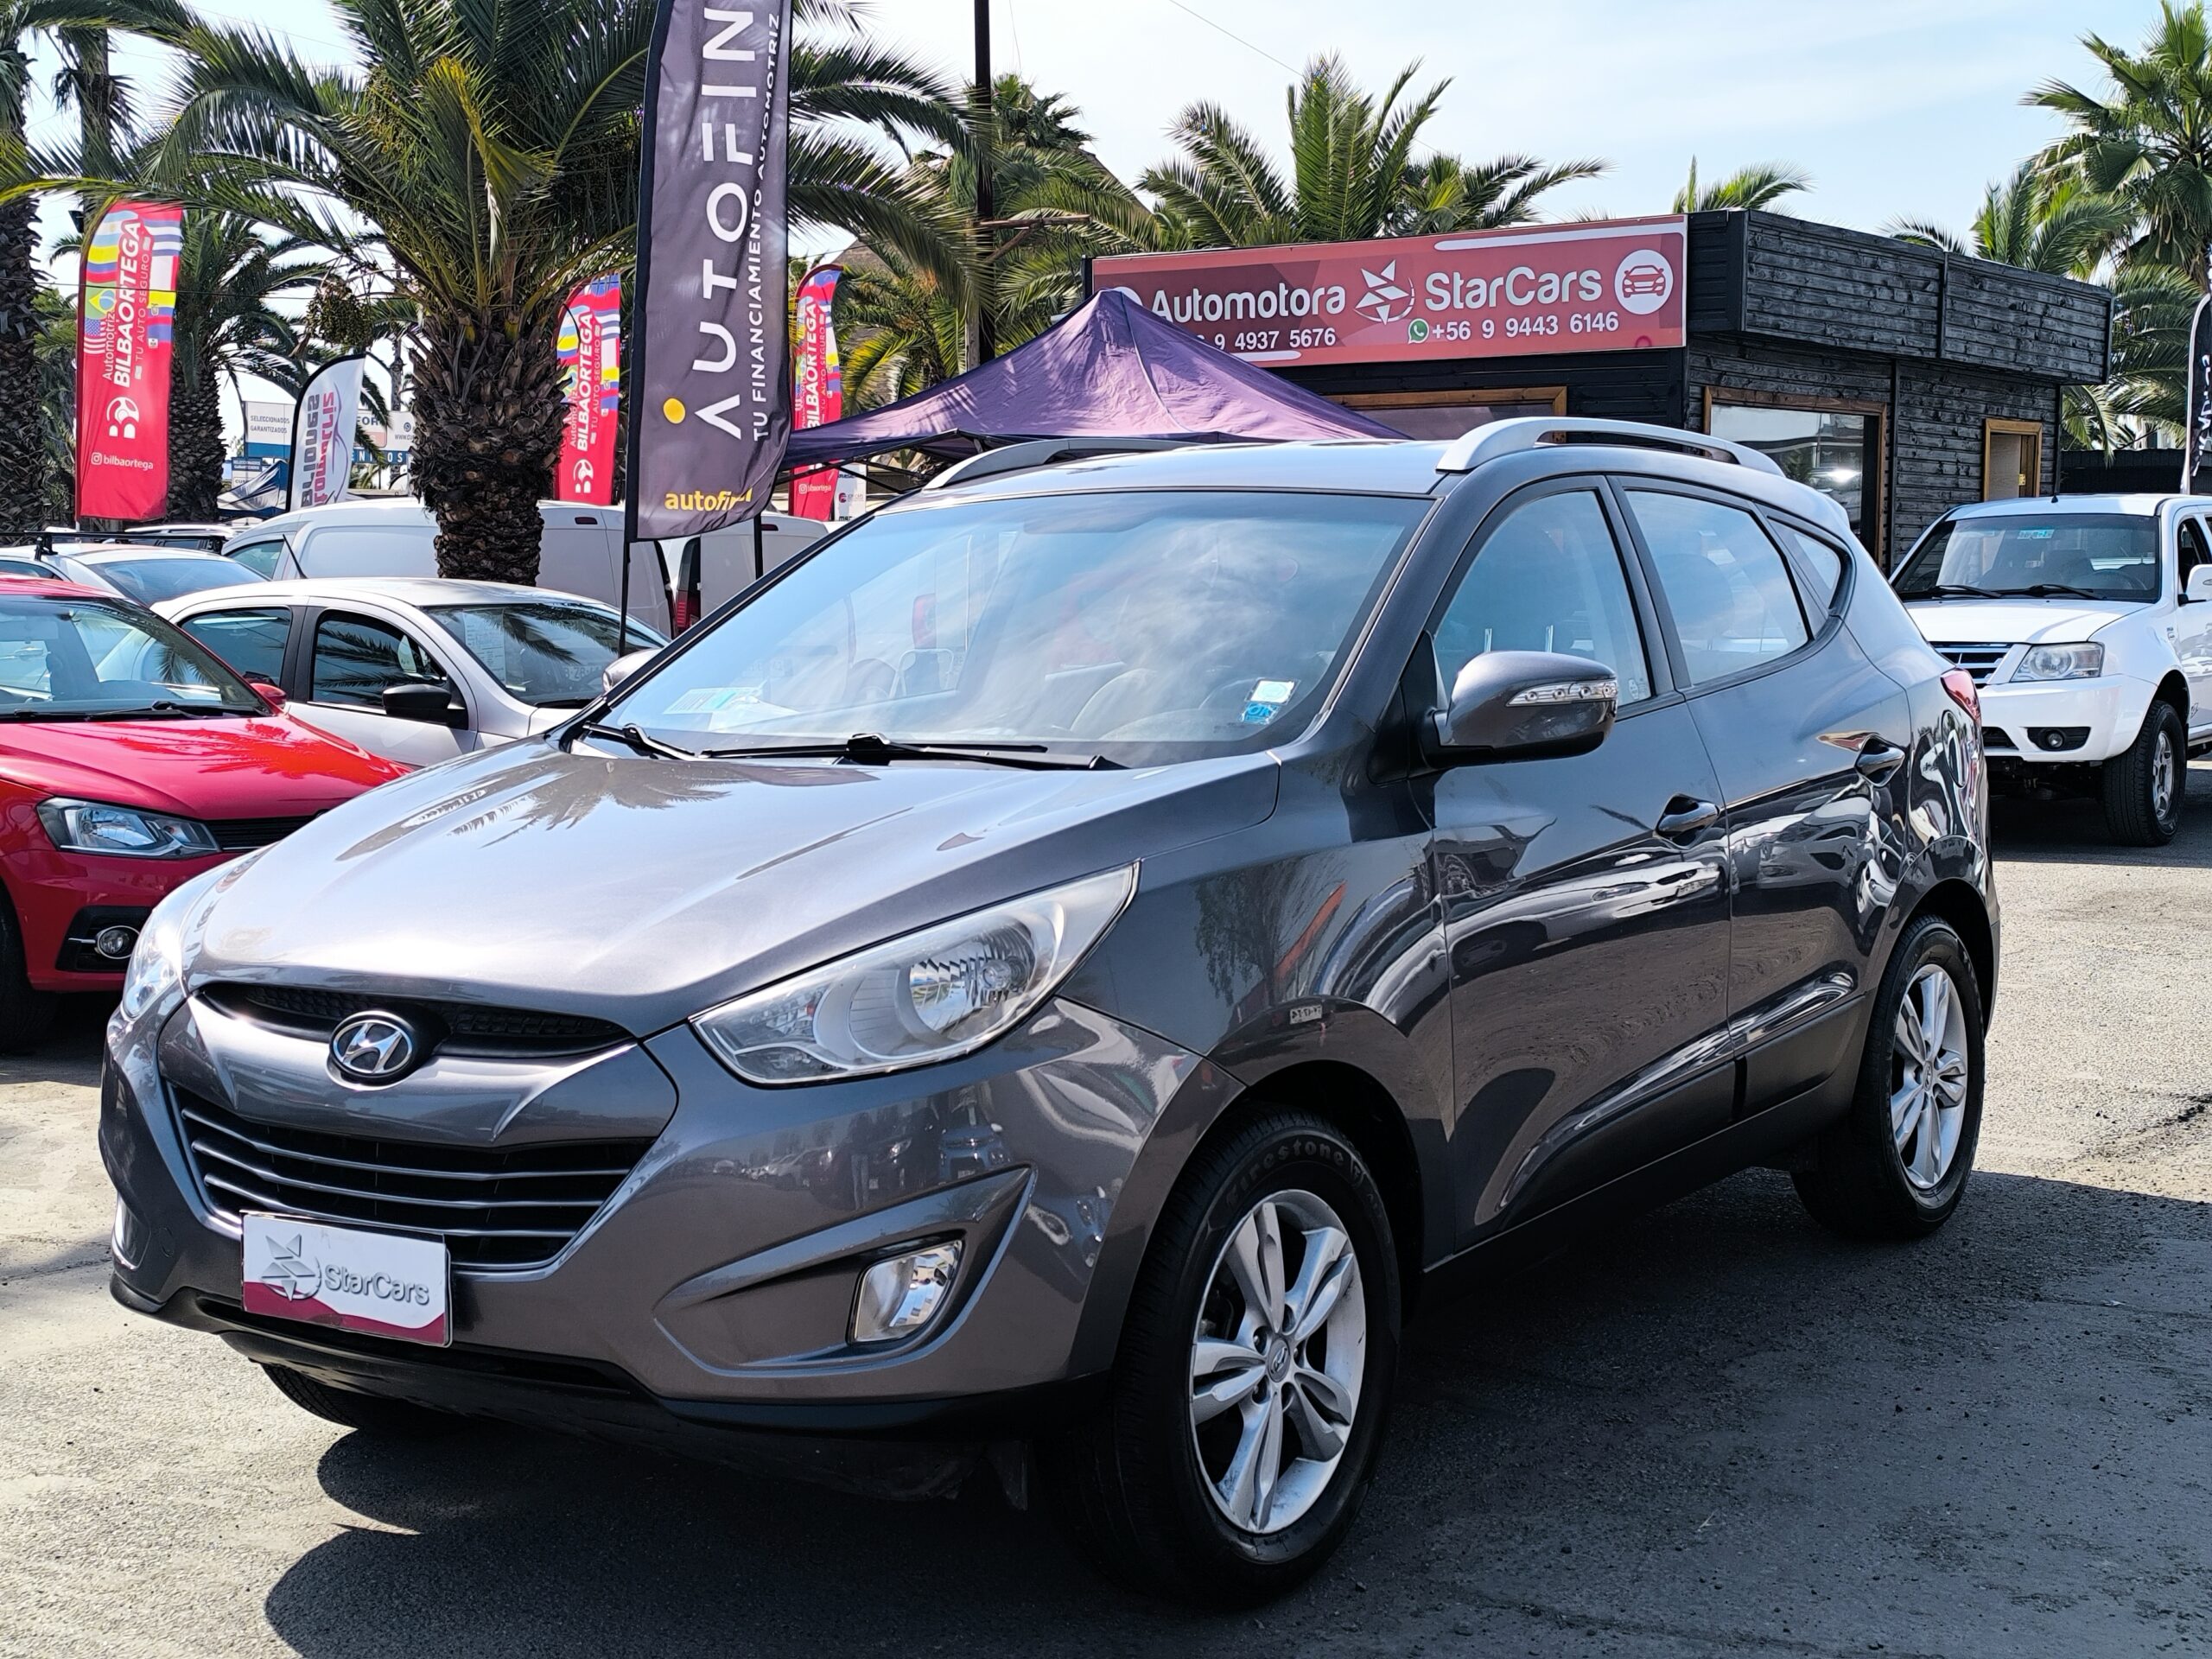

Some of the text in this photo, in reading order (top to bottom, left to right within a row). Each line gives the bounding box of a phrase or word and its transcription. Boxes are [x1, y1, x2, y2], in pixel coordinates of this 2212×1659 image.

[748, 13, 779, 442] TU FINANCIAMIENTO AUTOMOTRIZ
[113, 222, 142, 388] BILBAORTEGA
[135, 253, 150, 361] TU AUTO SEGURO
[1151, 282, 1346, 324] Automotora
[1425, 266, 1603, 312] StarCars
[102, 311, 116, 380] Automotriz
[1235, 330, 1280, 351] 4937
[1289, 327, 1337, 348] 5676
[1432, 311, 1619, 341] +56 9 9443 6146
[576, 314, 594, 452] BILBAORTEGA
[250, 415, 290, 424] SELECCIONADOS
[250, 425, 288, 434] GARANTIZADOS
[591, 415, 598, 429] TU
[103, 455, 154, 472] bilbaortega
[324, 1263, 430, 1306] StarCars
